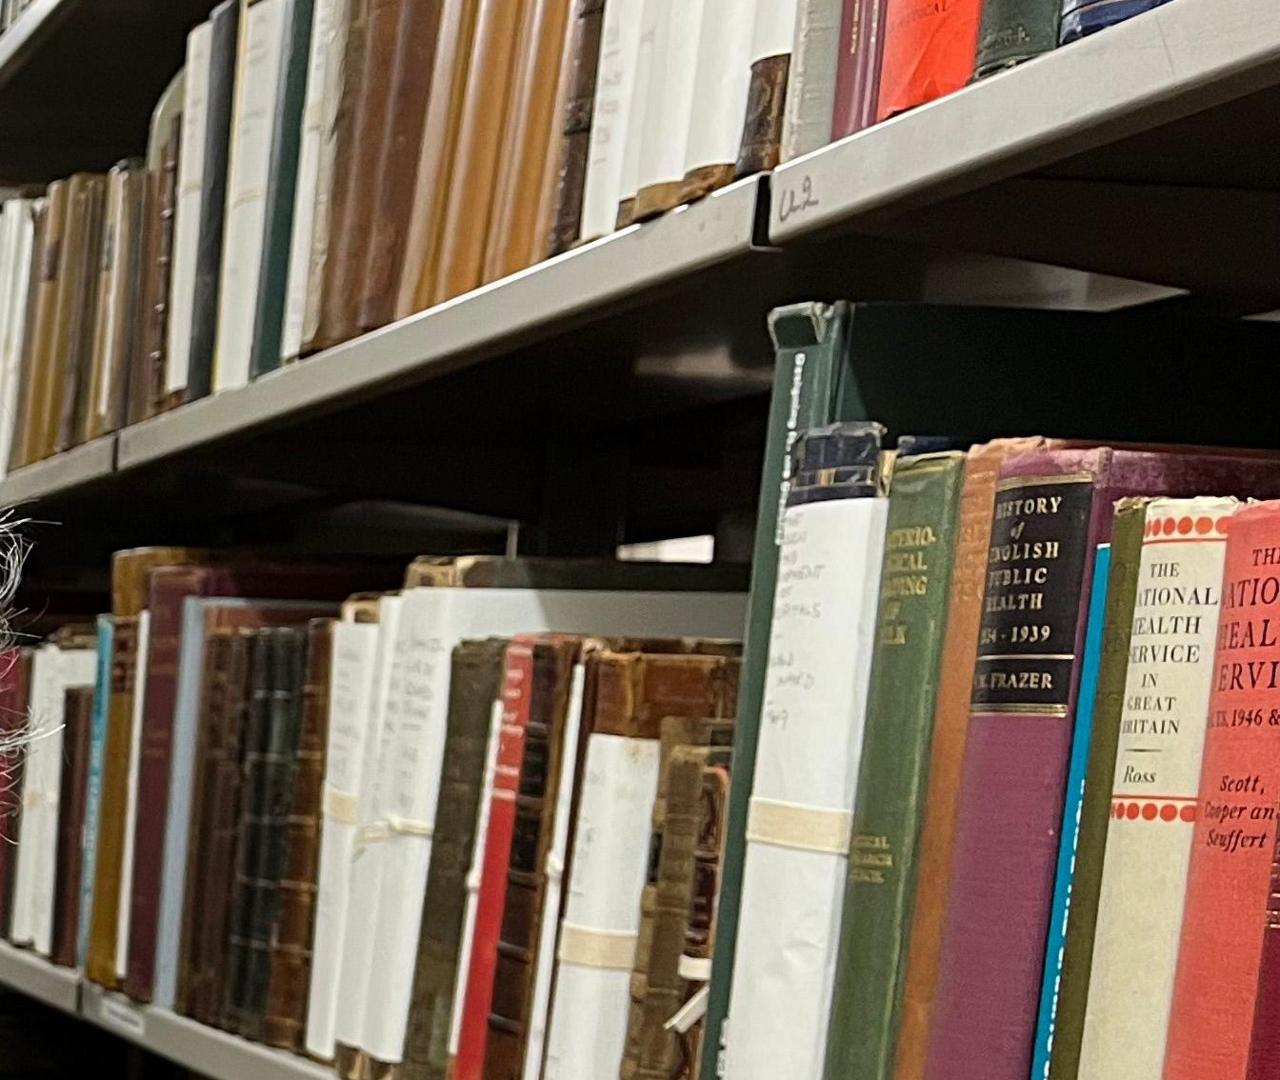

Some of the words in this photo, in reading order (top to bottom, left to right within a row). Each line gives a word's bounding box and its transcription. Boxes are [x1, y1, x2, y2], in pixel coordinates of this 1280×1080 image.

[1150, 562, 1180, 578] THE
[1010, 625, 1051, 643] 1939
[990, 672, 1053, 690] FRAZER
[1141, 673, 1161, 688] IN
[1127, 697, 1177, 713] GREAT
[1232, 709, 1263, 728] 1946
[1123, 765, 1157, 784] Ross
[1220, 775, 1266, 796] Scott,
[1206, 828, 1268, 853] Seuffert
